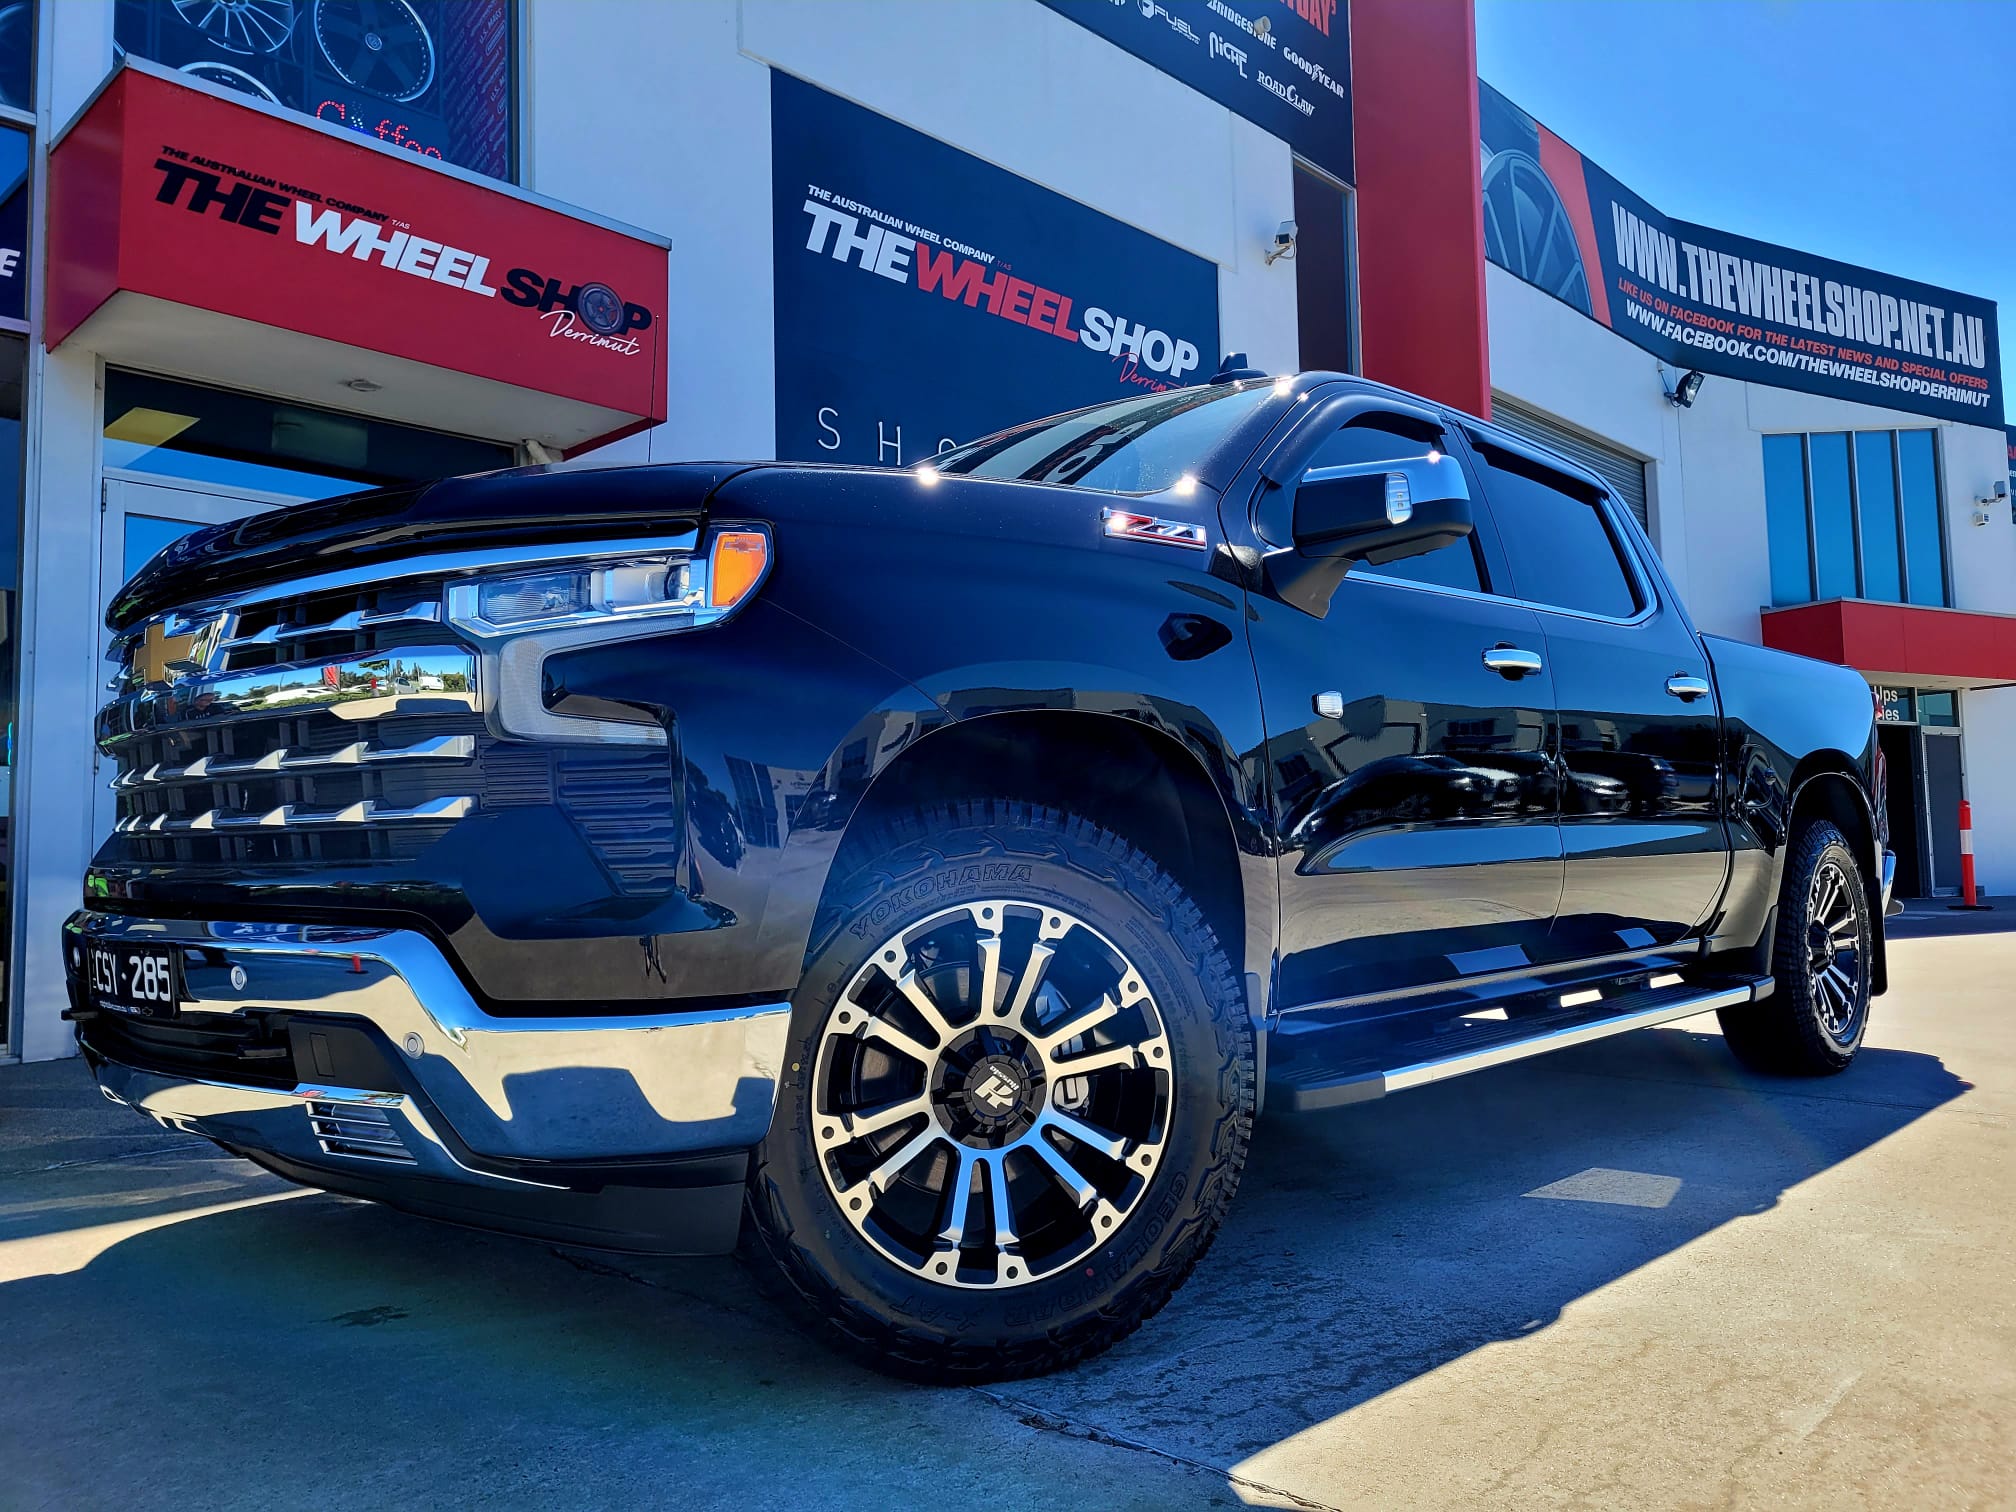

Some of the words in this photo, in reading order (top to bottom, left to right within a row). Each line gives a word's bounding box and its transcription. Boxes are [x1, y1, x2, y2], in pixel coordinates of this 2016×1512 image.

[1154, 4, 1200, 41] FUEL
[1283, 46, 1344, 98] GOODYEAR
[162, 145, 188, 161] THE
[190, 155, 277, 188] AUSTRALIAN
[278, 182, 323, 204] WHEEL
[325, 198, 389, 223] COMPANY
[807, 183, 832, 201] THE
[831, 195, 904, 230] AUSTRALIAN
[905, 222, 942, 245] WHEEL
[943, 237, 995, 264] COMPANY
[153, 157, 292, 236] THE
[295, 200, 497, 298] WHEEL
[500, 267, 652, 336] SHOP
[1611, 199, 1986, 370] WWW.THEWHEELSHOP.NET.AU
[802, 199, 917, 284] THE
[916, 241, 1079, 343] WHEEL
[1079, 306, 1200, 378] SHOP
[539, 309, 641, 357] Derrimut
[1618, 276, 1638, 298] LIKE
[1639, 289, 1653, 307] US
[1654, 297, 1669, 316] ON
[1670, 305, 1735, 335] FACEBOOK
[1737, 324, 1762, 341] FOR
[1765, 331, 1788, 347] THE
[1791, 336, 1835, 357] LATEST
[1837, 346, 1873, 364] NEWS
[1875, 355, 1899, 370] AND
[1901, 362, 1947, 382] SPECIAL
[1949, 372, 1989, 390] OFFERS
[1625, 298, 1991, 408] WWW.FACEBOOK.COM/THEWHEELSHOPDERRIMUT
[849, 863, 1033, 940] YOKOHAMA
[95, 950, 118, 996] CSY
[128, 955, 171, 1002] 285
